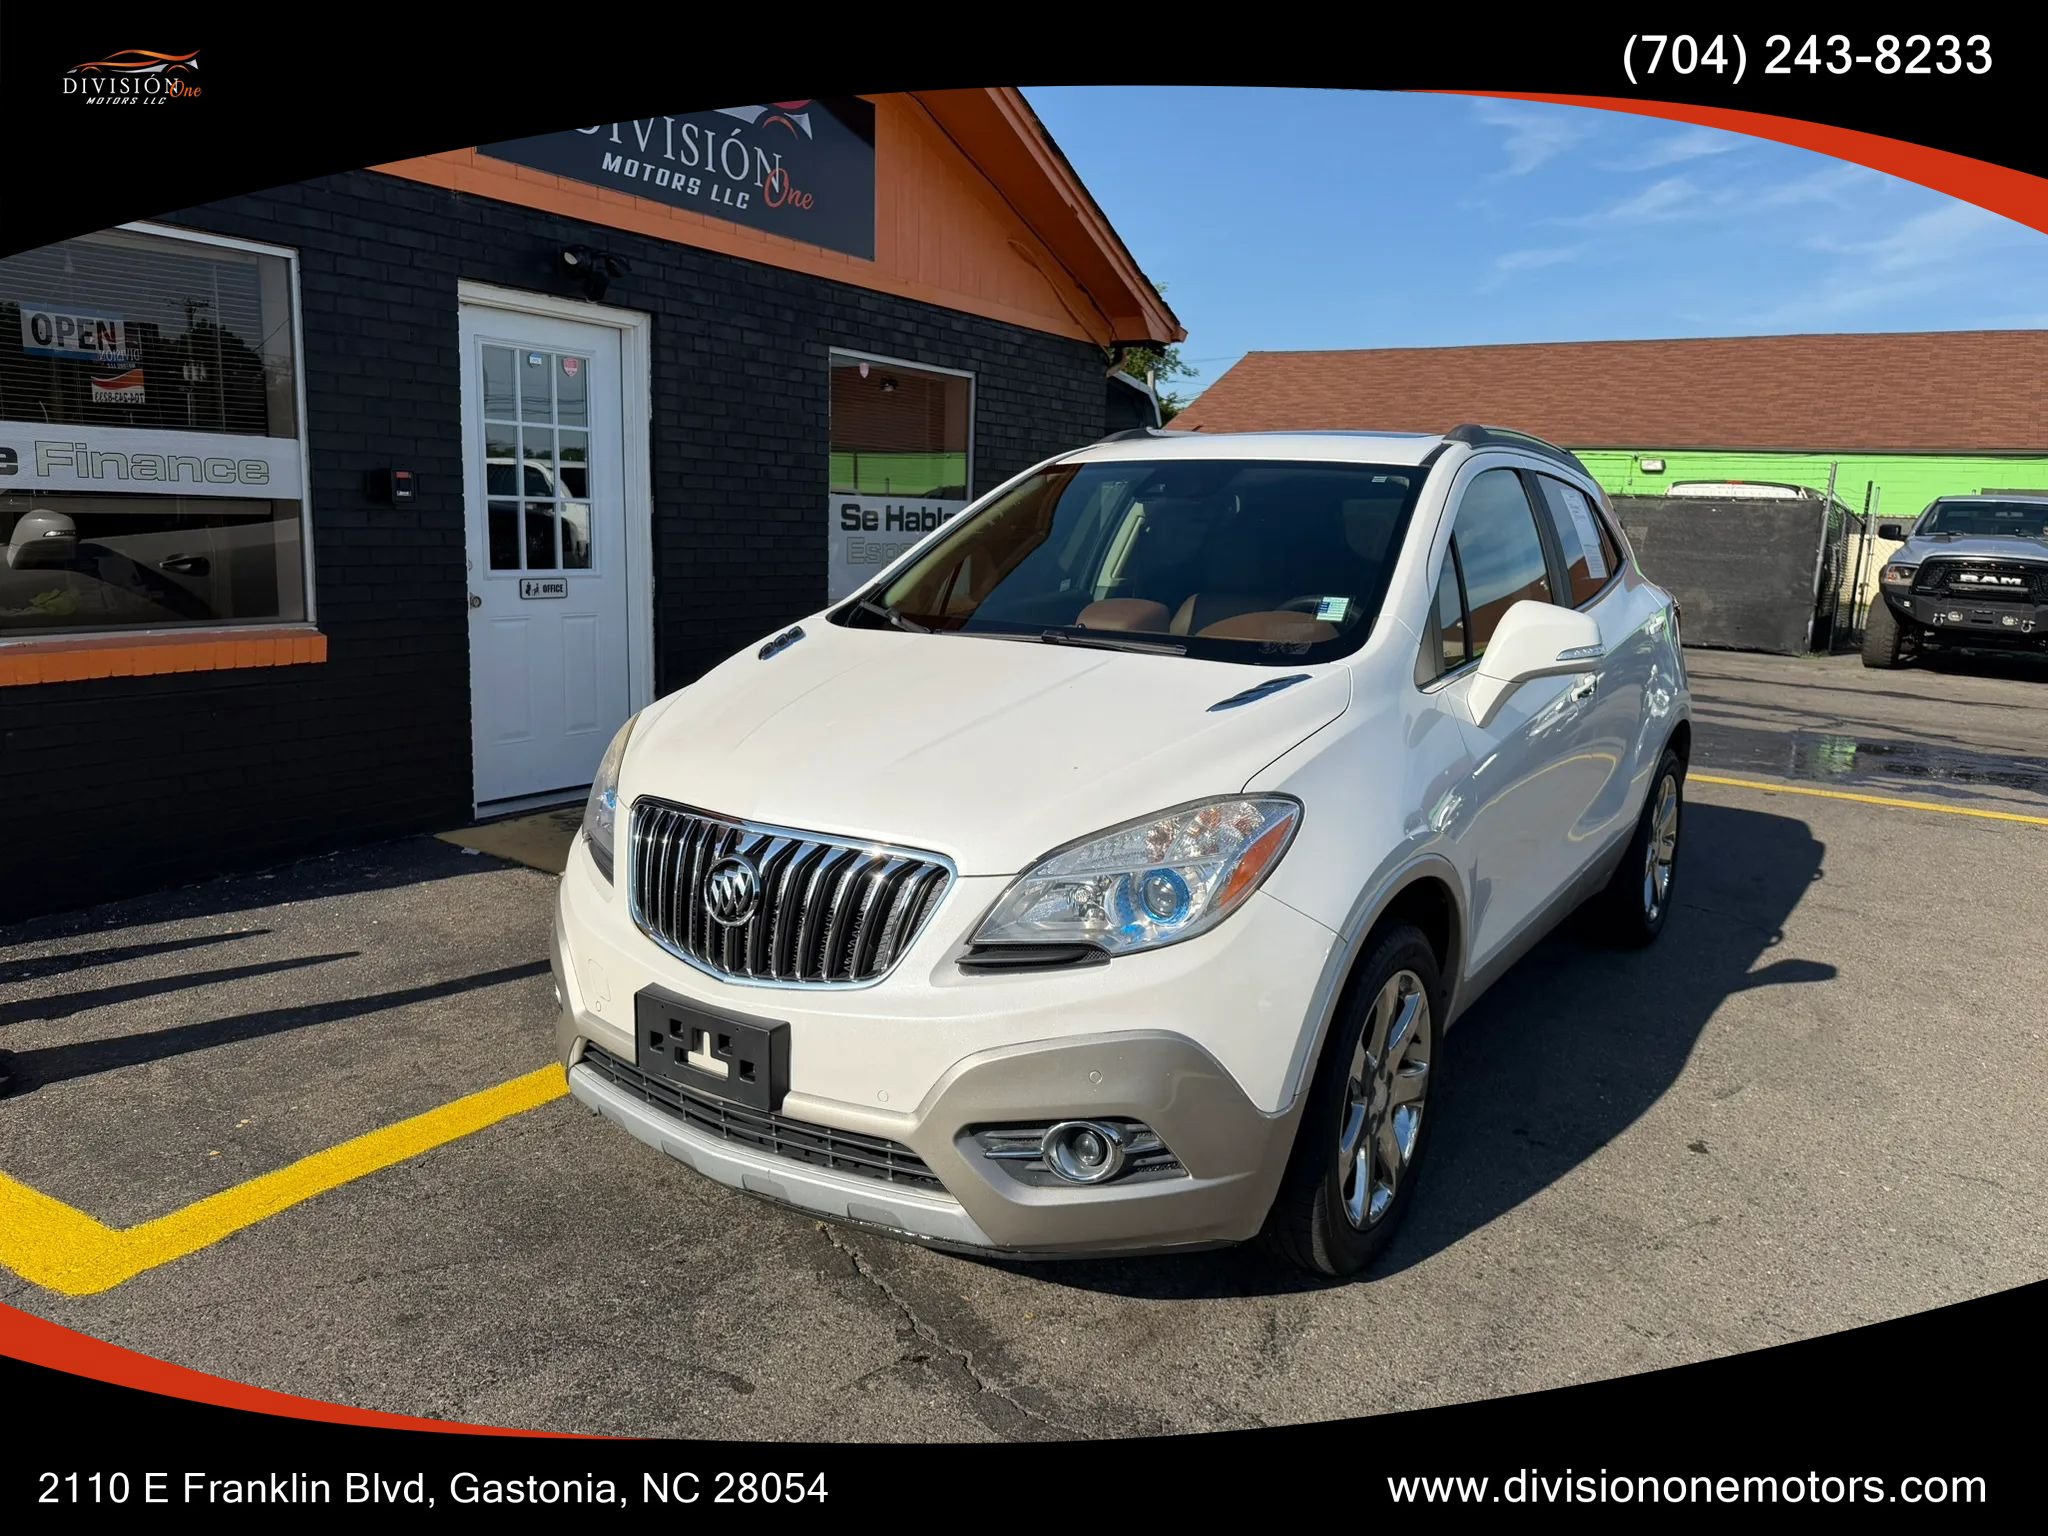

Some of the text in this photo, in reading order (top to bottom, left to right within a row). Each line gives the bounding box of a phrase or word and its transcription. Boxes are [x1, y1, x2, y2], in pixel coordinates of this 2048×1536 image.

[575, 115, 815, 209] VISIÓN One
[601, 151, 750, 210] MOTORS LLC
[31, 313, 117, 352] OPEN
[34, 440, 270, 485] Finance
[841, 503, 879, 532] Se
[542, 583, 563, 593] OFFICE
[1960, 574, 2022, 586] RAM
